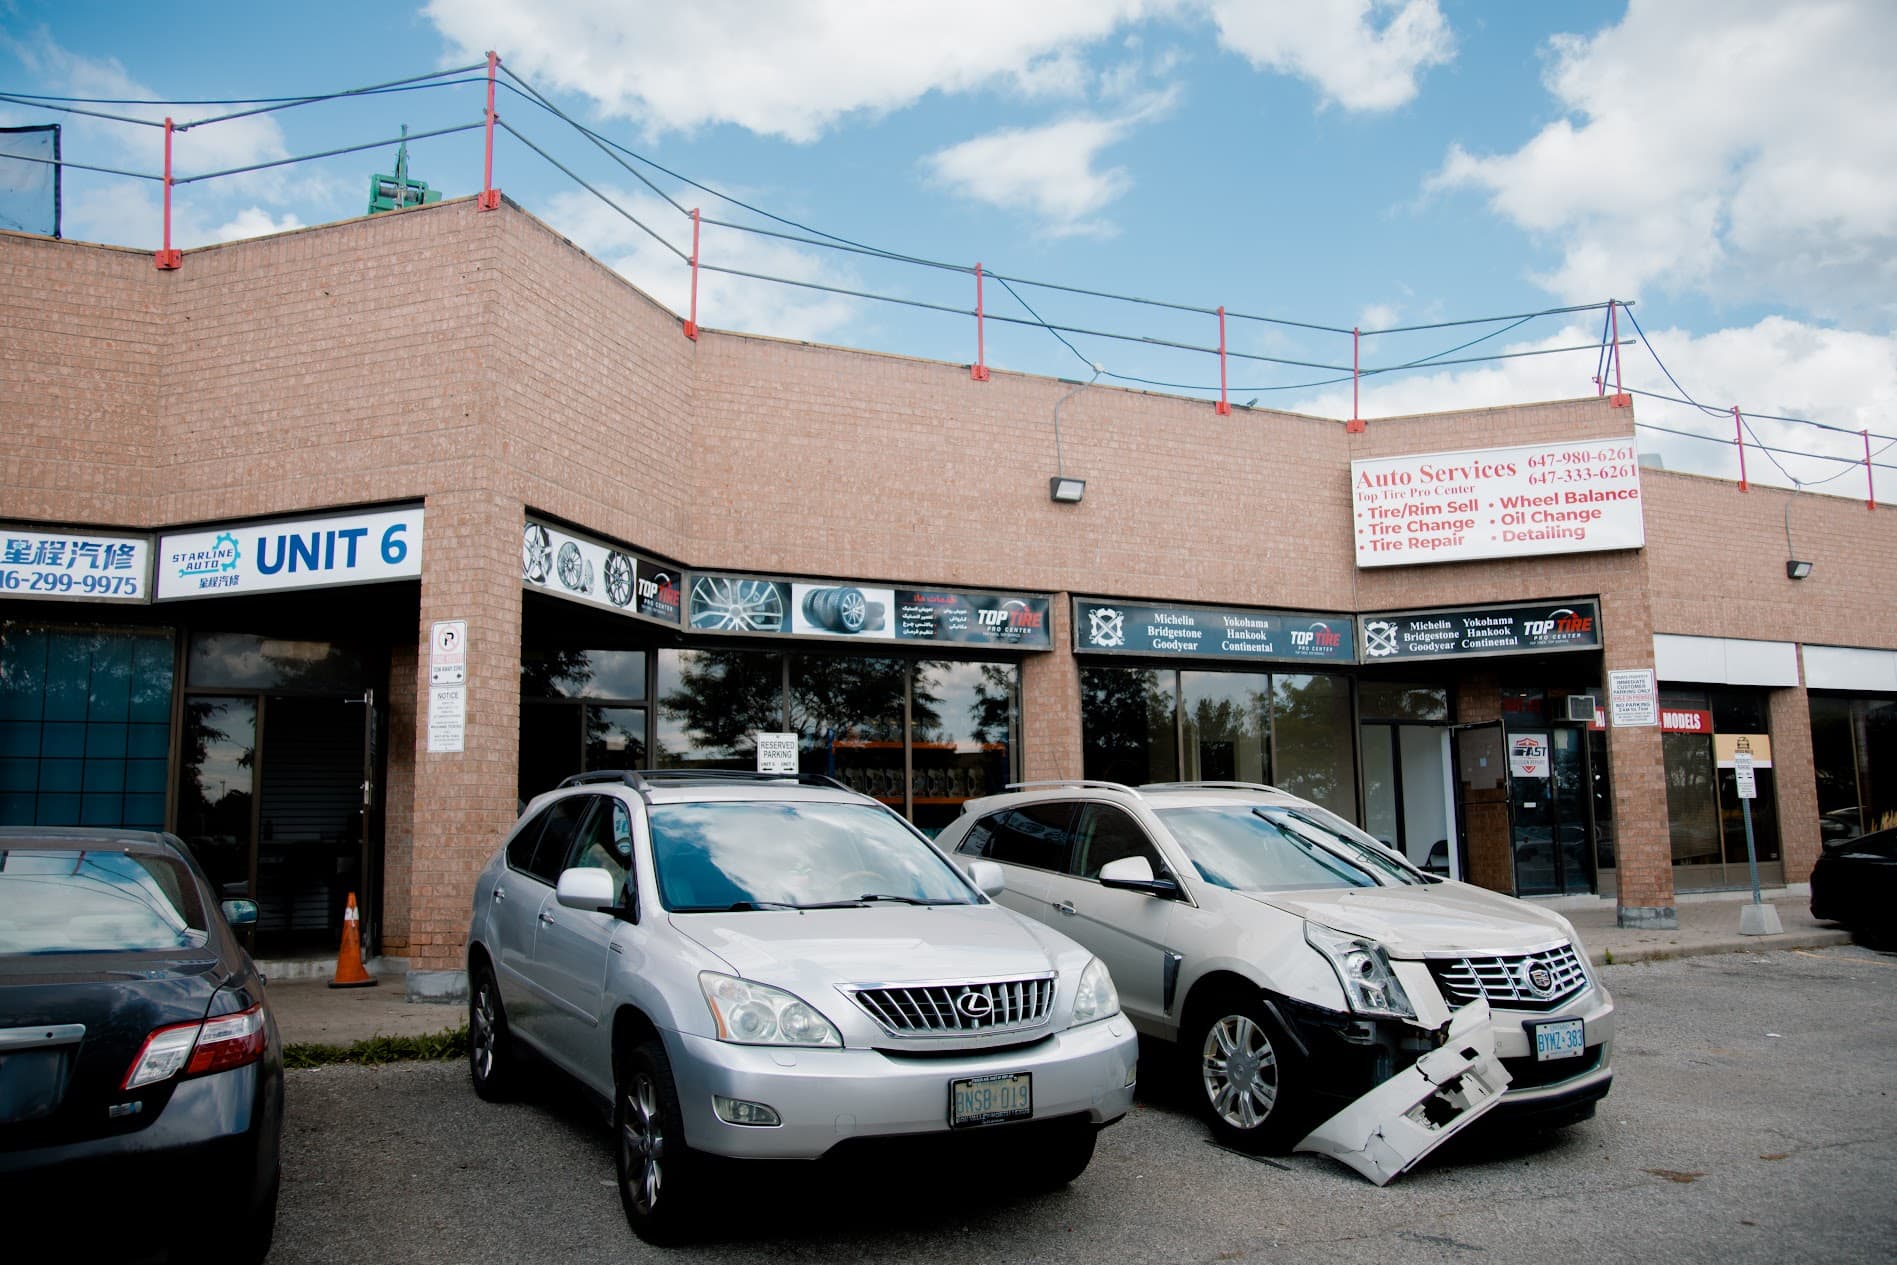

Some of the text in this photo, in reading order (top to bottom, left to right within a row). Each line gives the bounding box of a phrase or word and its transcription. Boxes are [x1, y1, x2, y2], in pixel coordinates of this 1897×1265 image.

[1528, 447, 1634, 468] 647-980-6261
[1357, 460, 1517, 488] Auto Services
[1528, 464, 1636, 485] 647-333-6261
[1357, 484, 1475, 503] Top Tire Pro Center
[1500, 488, 1638, 509] Wheel Balance
[1368, 498, 1479, 519] Tire/Rim Sell
[1501, 508, 1602, 526] Oil Change
[1368, 518, 1475, 535] Tire Change
[1502, 525, 1586, 542] Detailing
[257, 523, 407, 575] UNIT 6
[1369, 533, 1464, 552] Tire Repair
[0, 538, 136, 571] 星程汽修
[172, 549, 233, 563] STARLINE
[186, 560, 219, 570] AUTO
[199, 575, 240, 589] 星程汽修
[638, 578, 658, 599] TOP
[977, 609, 1042, 627] TOP TIRE
[1154, 613, 1194, 625] Michelin
[1223, 616, 1268, 628] Yokohama
[1410, 620, 1451, 631] Michelin
[1462, 617, 1513, 627] Yokohama
[1147, 626, 1202, 639] Bridgestone
[1467, 626, 1511, 637] Hankook
[1523, 617, 1592, 635] TOP TIRE
[1227, 629, 1267, 640] Hankook
[1291, 631, 1341, 646] TOP TIRE
[1404, 631, 1459, 642] Bridgestone
[1462, 636, 1518, 648] Continental
[1152, 638, 1198, 651] Goodyear
[1222, 641, 1273, 652] Continental
[1409, 641, 1455, 652] Goodyear
[1662, 712, 1701, 730] MODELS
[760, 741, 795, 750] RESERVED
[1512, 746, 1547, 756] FAST
[763, 750, 792, 759] PARKING
[1566, 1029, 1583, 1048] 383
[1001, 1086, 1028, 1108] 019
